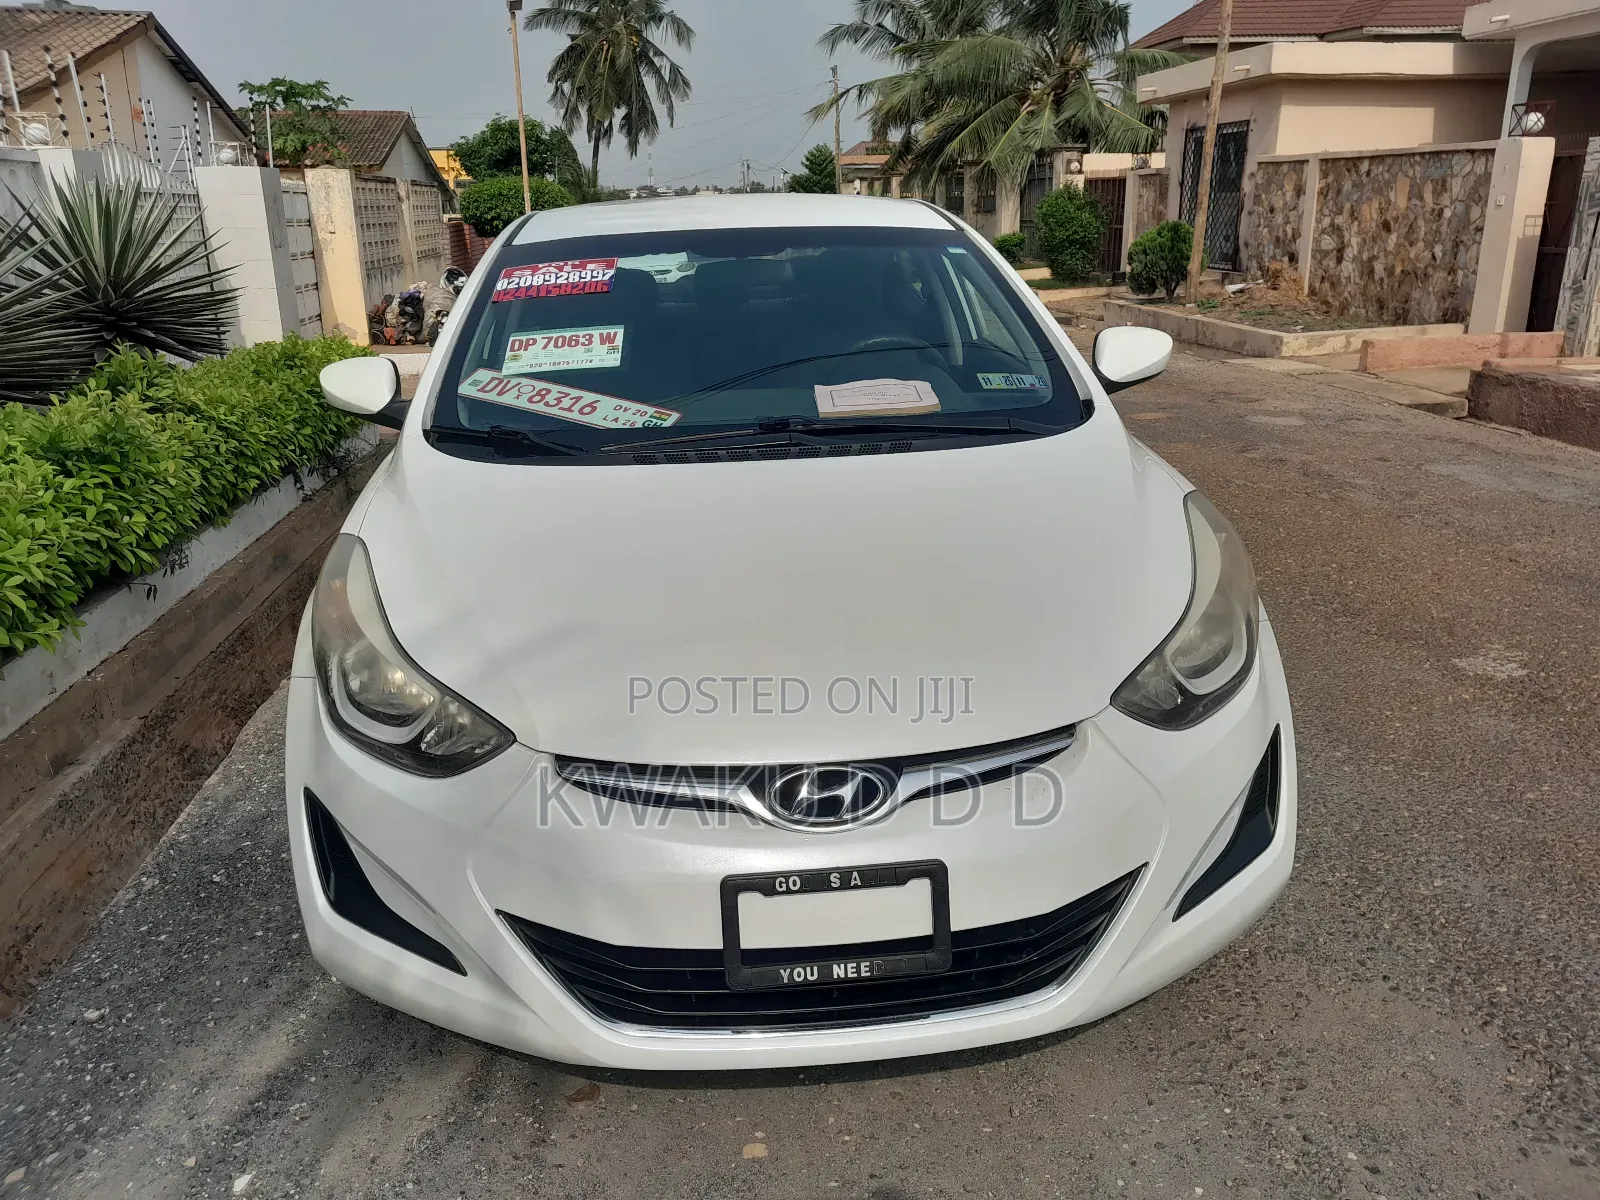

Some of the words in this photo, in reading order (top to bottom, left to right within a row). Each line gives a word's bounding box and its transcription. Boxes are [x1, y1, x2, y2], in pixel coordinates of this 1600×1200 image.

[511, 263, 607, 276] SALE
[496, 270, 614, 290] 0208928997
[509, 337, 538, 353] DP
[541, 333, 595, 350] 7063
[598, 331, 618, 346] W
[476, 376, 522, 397] DV
[526, 387, 601, 417] 8316
[613, 404, 632, 413] DV
[632, 408, 648, 417] 20
[602, 414, 620, 424] LA
[622, 419, 638, 428] 26
[641, 419, 664, 428] GH
[779, 966, 819, 983] YOU
